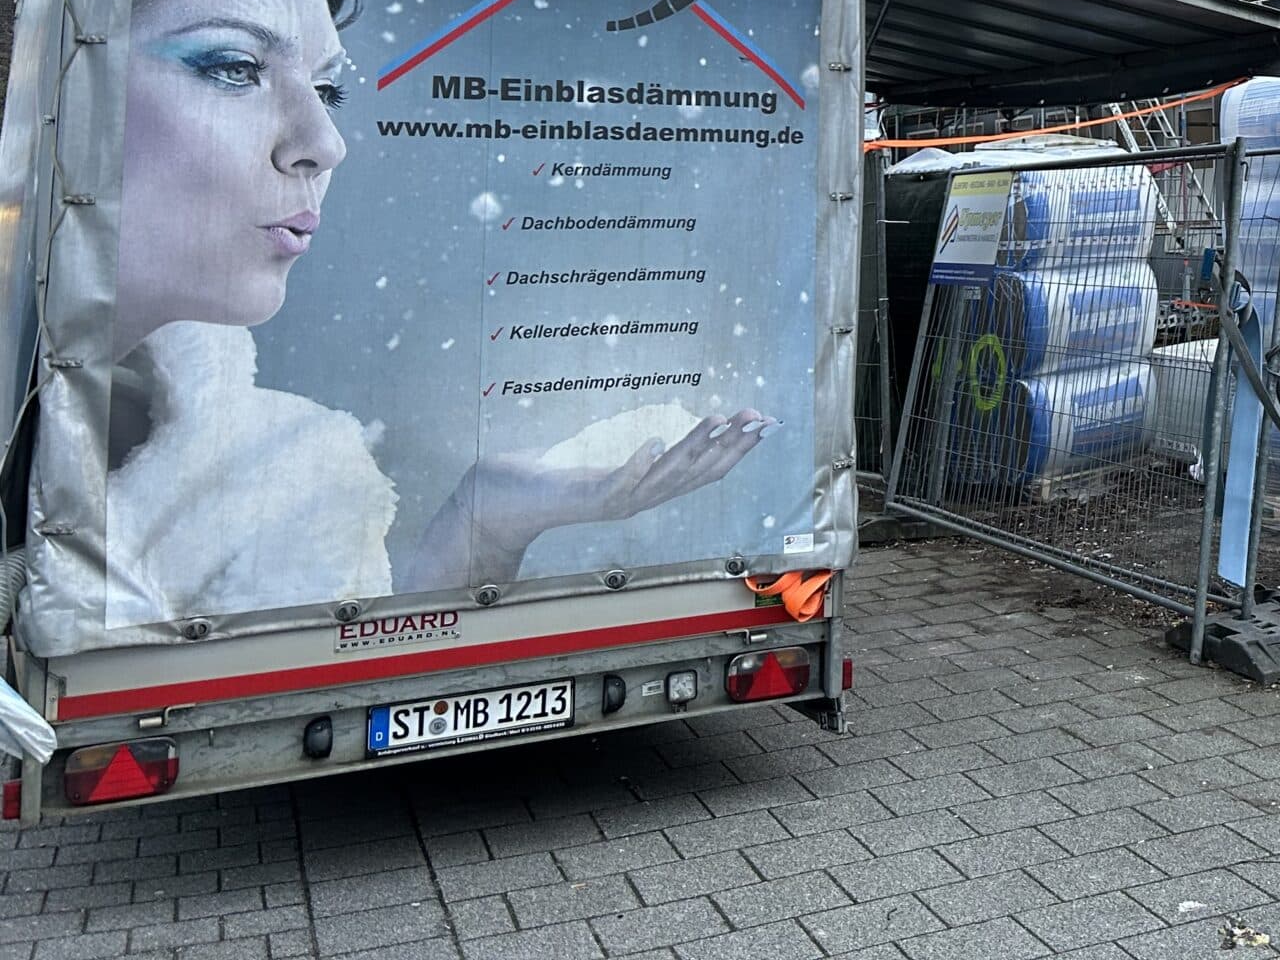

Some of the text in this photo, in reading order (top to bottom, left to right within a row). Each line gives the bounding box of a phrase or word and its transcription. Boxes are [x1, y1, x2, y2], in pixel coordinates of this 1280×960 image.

[432, 75, 778, 115] MB-Einblasdämmung
[376, 119, 804, 148] www.mb-einblasdaemmung.de
[551, 162, 672, 180] Kerndämmung
[521, 216, 697, 232] Dachbodendämmung
[506, 269, 706, 286] Dachschrägendämmung
[509, 321, 699, 340] Kellerdeckendämmung
[502, 372, 702, 396] Fassadenimprägnierung
[340, 610, 459, 640] EDUARD
[340, 630, 458, 649] WWW.EDUARD.NL
[392, 704, 430, 740] ST
[453, 697, 490, 731] MB
[498, 685, 567, 724] 1213
[375, 732, 383, 742] D
